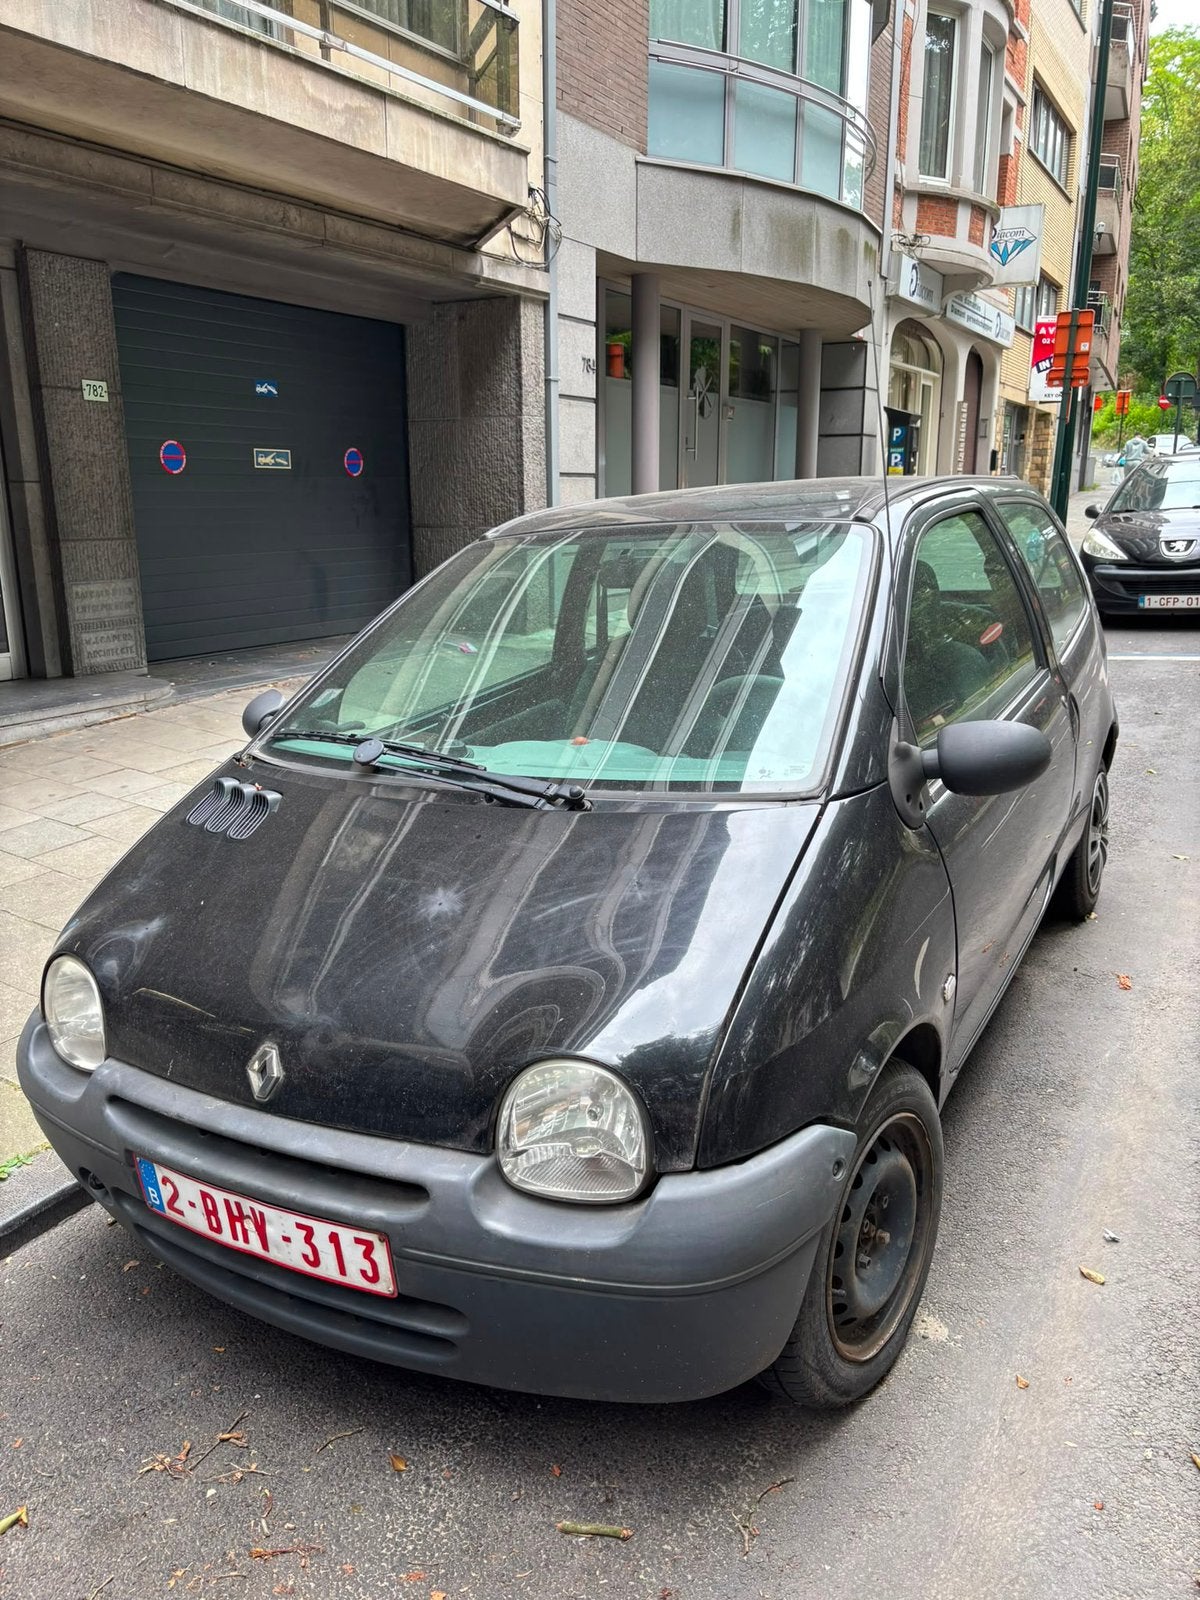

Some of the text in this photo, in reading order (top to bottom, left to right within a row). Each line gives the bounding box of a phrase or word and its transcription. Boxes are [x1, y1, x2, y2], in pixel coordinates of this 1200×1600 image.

[1039, 359, 1051, 371] IN
[86, 383, 105, 398] 782
[893, 427, 902, 441] P
[148, 1187, 160, 1205] B
